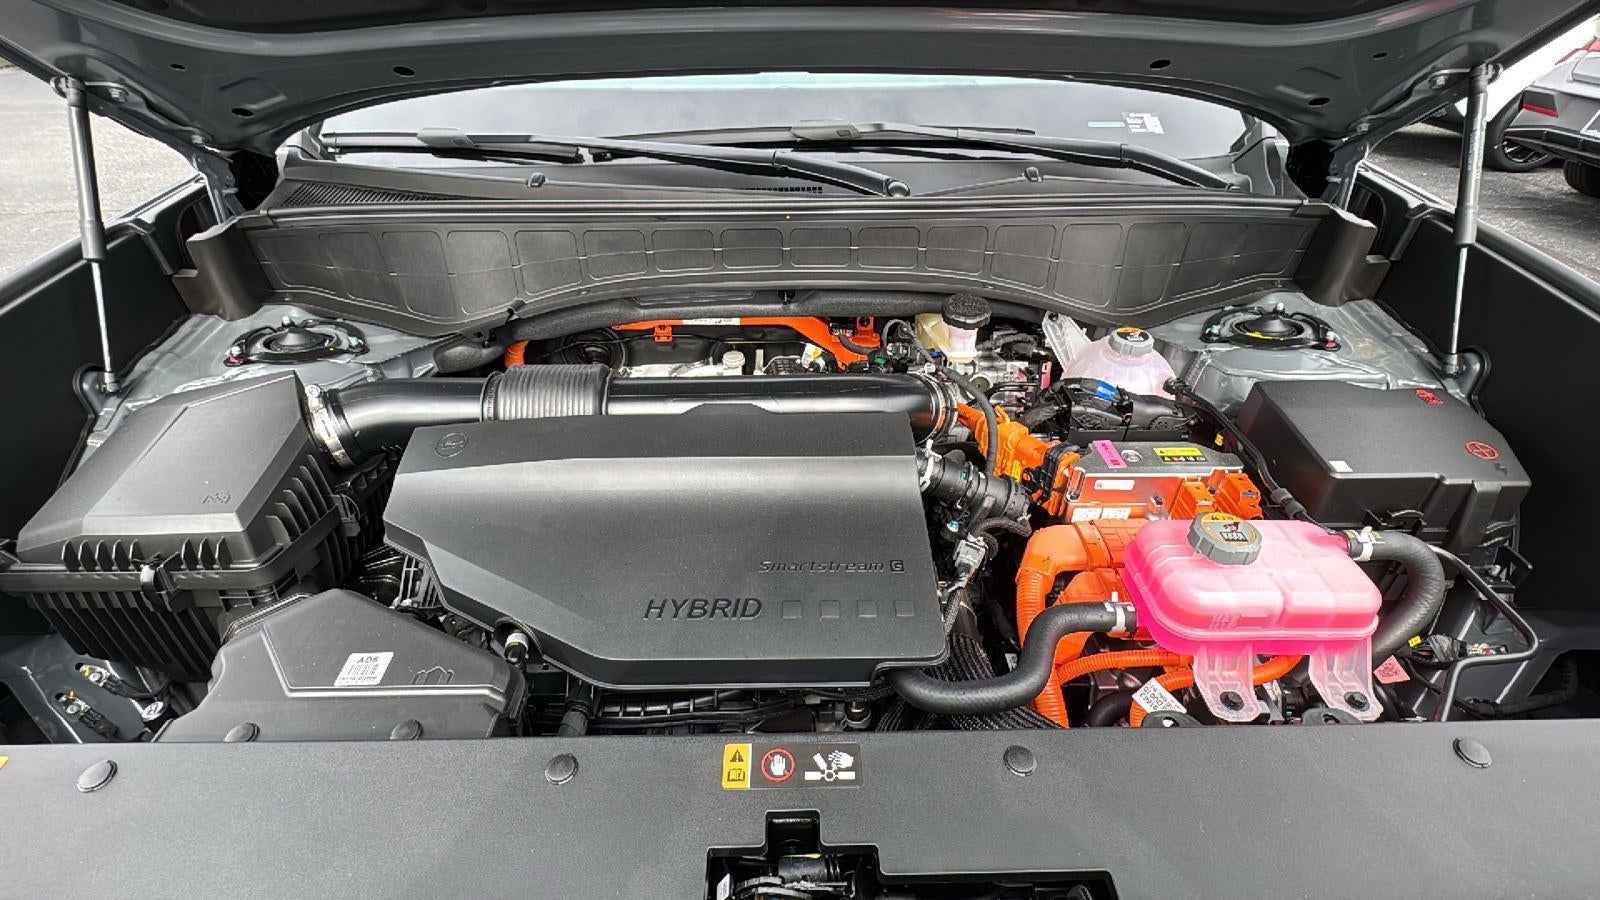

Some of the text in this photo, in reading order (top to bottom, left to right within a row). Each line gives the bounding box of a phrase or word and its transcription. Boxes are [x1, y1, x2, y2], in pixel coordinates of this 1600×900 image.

[758, 559, 905, 574] Smartstream G
[643, 598, 763, 621] HYBRID
